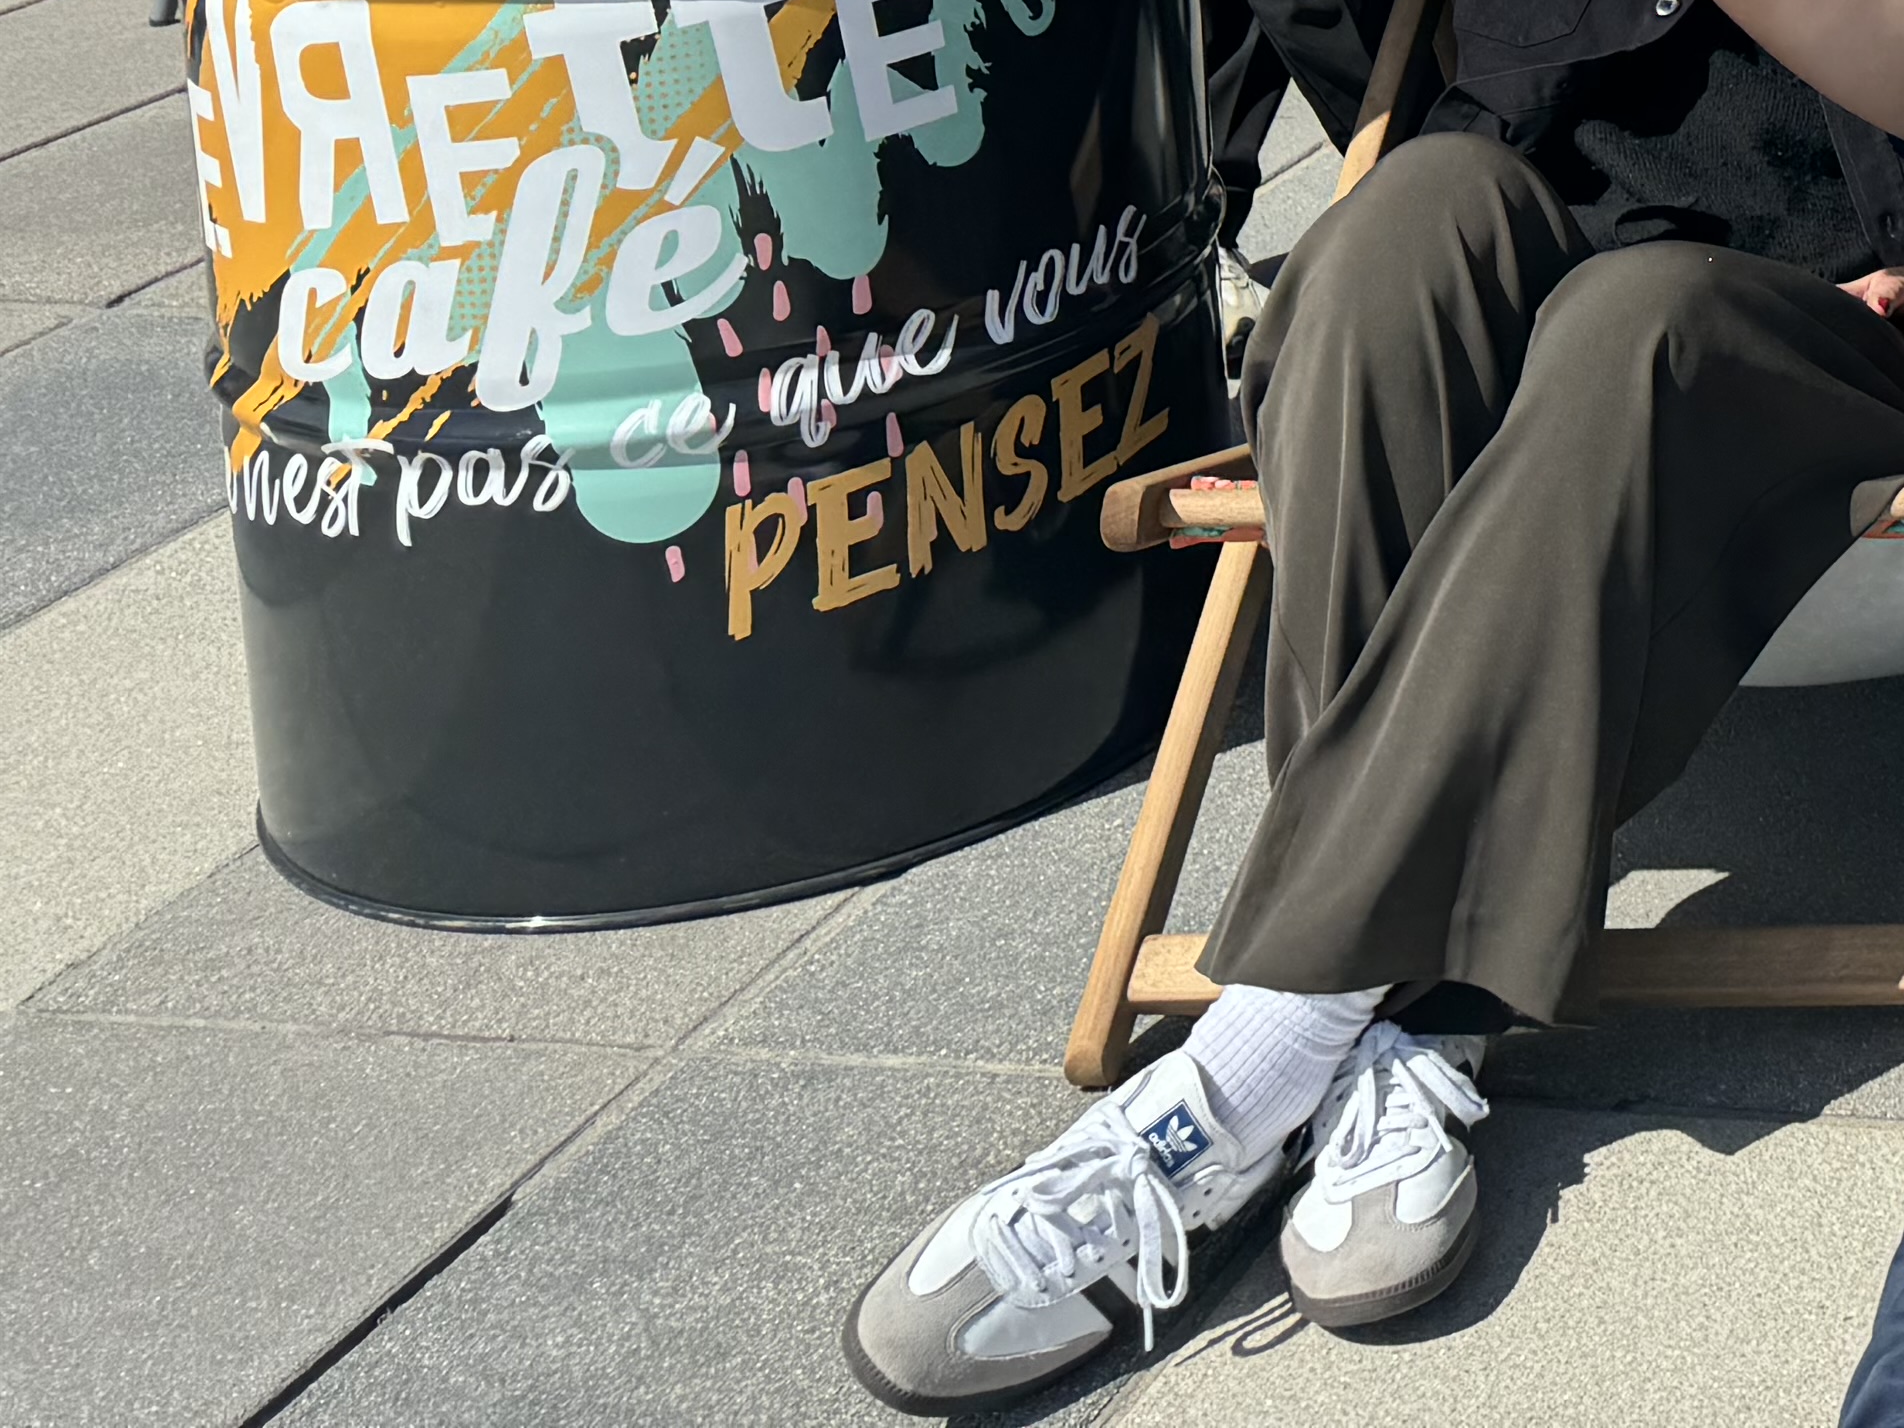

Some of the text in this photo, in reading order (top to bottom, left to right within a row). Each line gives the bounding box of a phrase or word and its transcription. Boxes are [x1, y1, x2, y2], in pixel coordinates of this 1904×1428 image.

[277, 135, 749, 413] café
[396, 434, 576, 547] pas
[609, 391, 737, 468] ce
[769, 307, 960, 448] que
[983, 204, 1147, 345] vous
[724, 312, 1171, 642] PENSEZ
